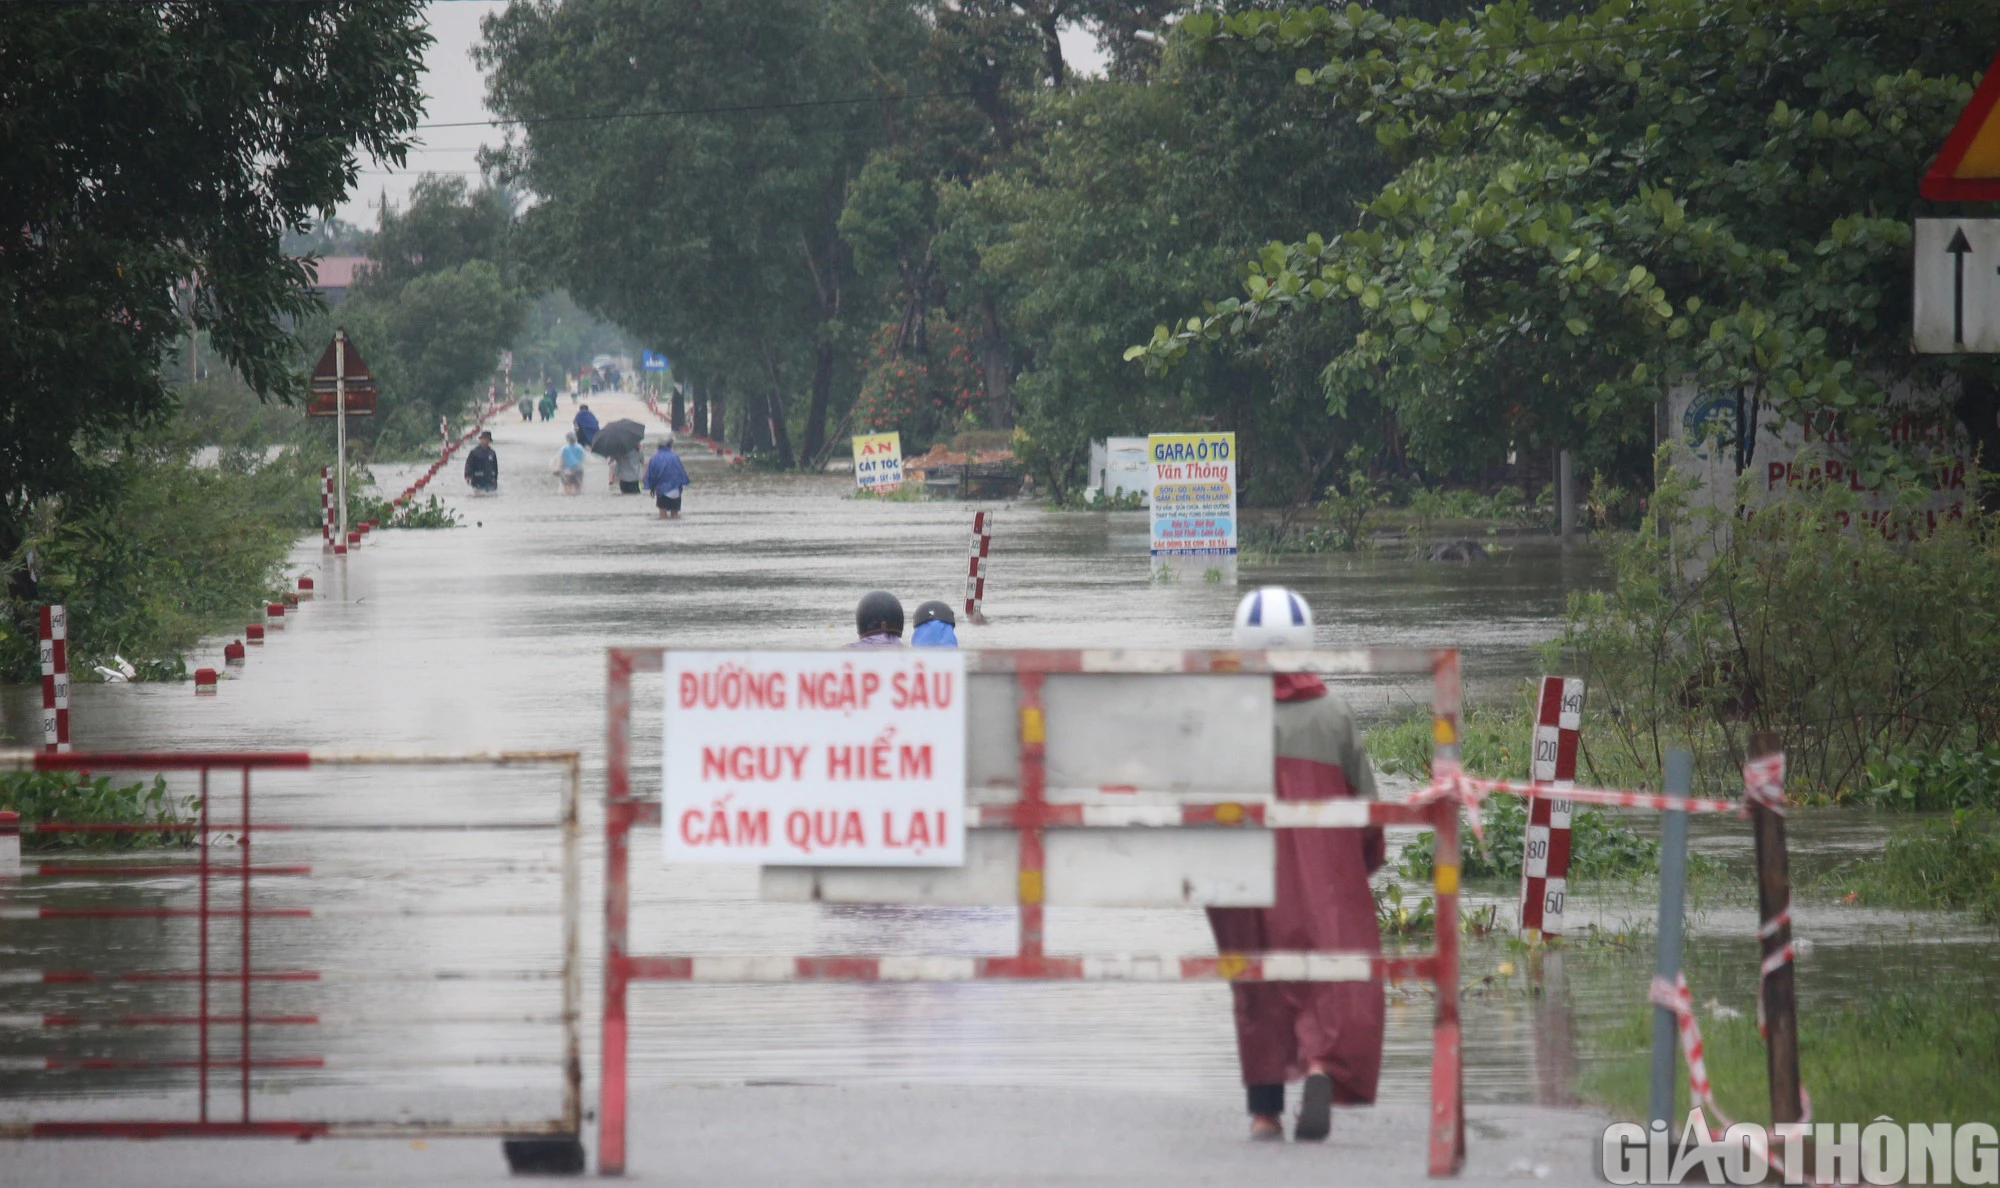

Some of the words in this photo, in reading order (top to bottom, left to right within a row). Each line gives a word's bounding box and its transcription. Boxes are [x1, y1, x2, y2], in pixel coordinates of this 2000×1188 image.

[1155, 442, 1195, 460] GARA
[1197, 438, 1208, 460] Ô
[1211, 438, 1229, 460] TÔ
[1186, 462, 1228, 482] Thông
[52, 614, 64, 628] 140
[41, 648, 53, 663] 120
[55, 684, 67, 698] 100
[679, 661, 786, 710] ĐƯỜNG
[797, 661, 880, 717] NGẬP
[891, 662, 952, 710] SÂU
[1561, 694, 1582, 715] 140
[44, 718, 56, 732] 80
[701, 744, 810, 781] NGUY
[827, 725, 934, 781] HIỂM
[1536, 740, 1556, 762] 120
[679, 791, 770, 848] CẤM
[785, 809, 865, 855] QUA
[882, 809, 946, 856] LẠI
[1528, 840, 1546, 859] 80
[1545, 892, 1564, 915] 60
